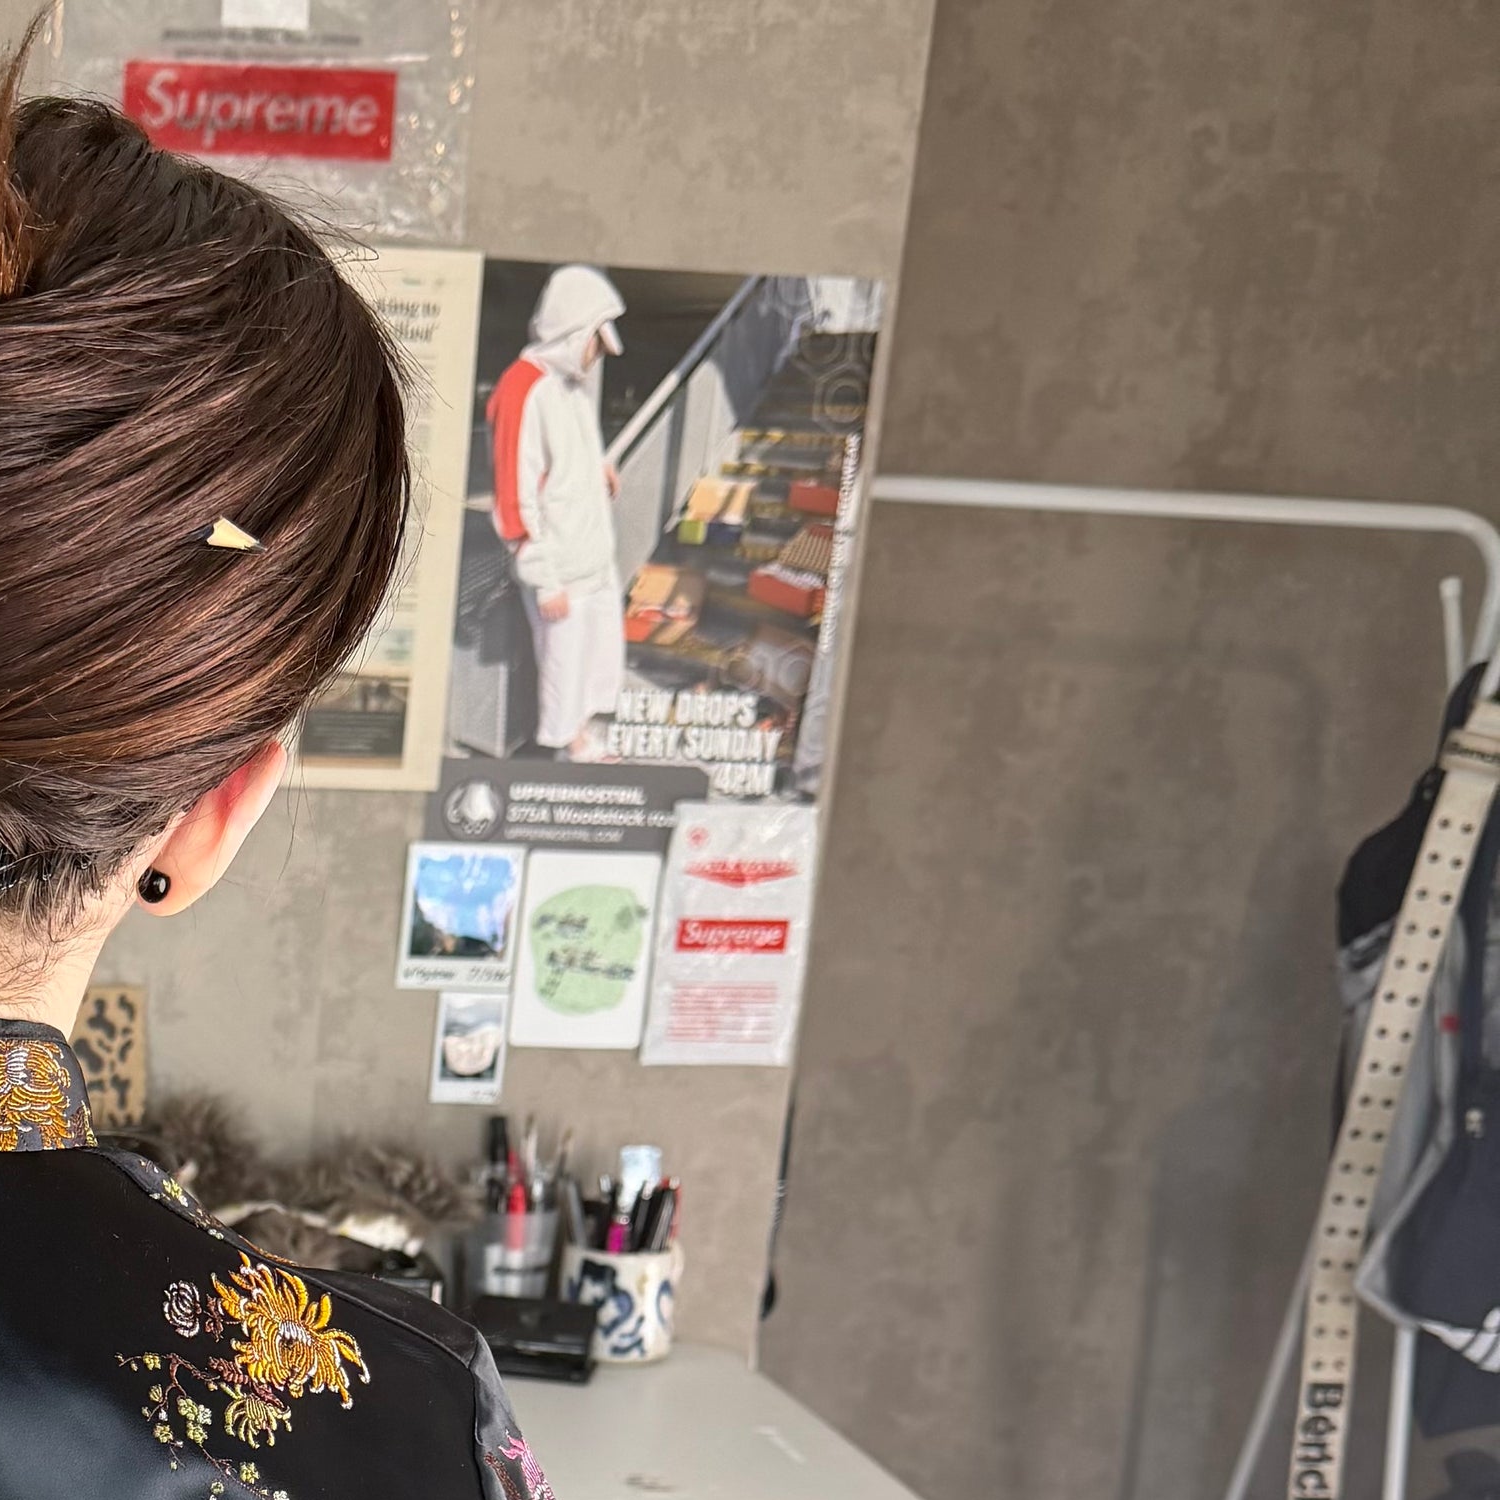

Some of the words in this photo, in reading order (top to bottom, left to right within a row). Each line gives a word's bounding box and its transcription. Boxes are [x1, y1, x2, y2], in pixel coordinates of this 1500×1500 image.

[142, 67, 379, 148] Supreme
[615, 690, 675, 724] NEW
[675, 690, 759, 728] DROPS
[607, 724, 684, 758] EVERY
[683, 726, 783, 762] SUNDAY
[552, 803, 646, 827] Woodstock
